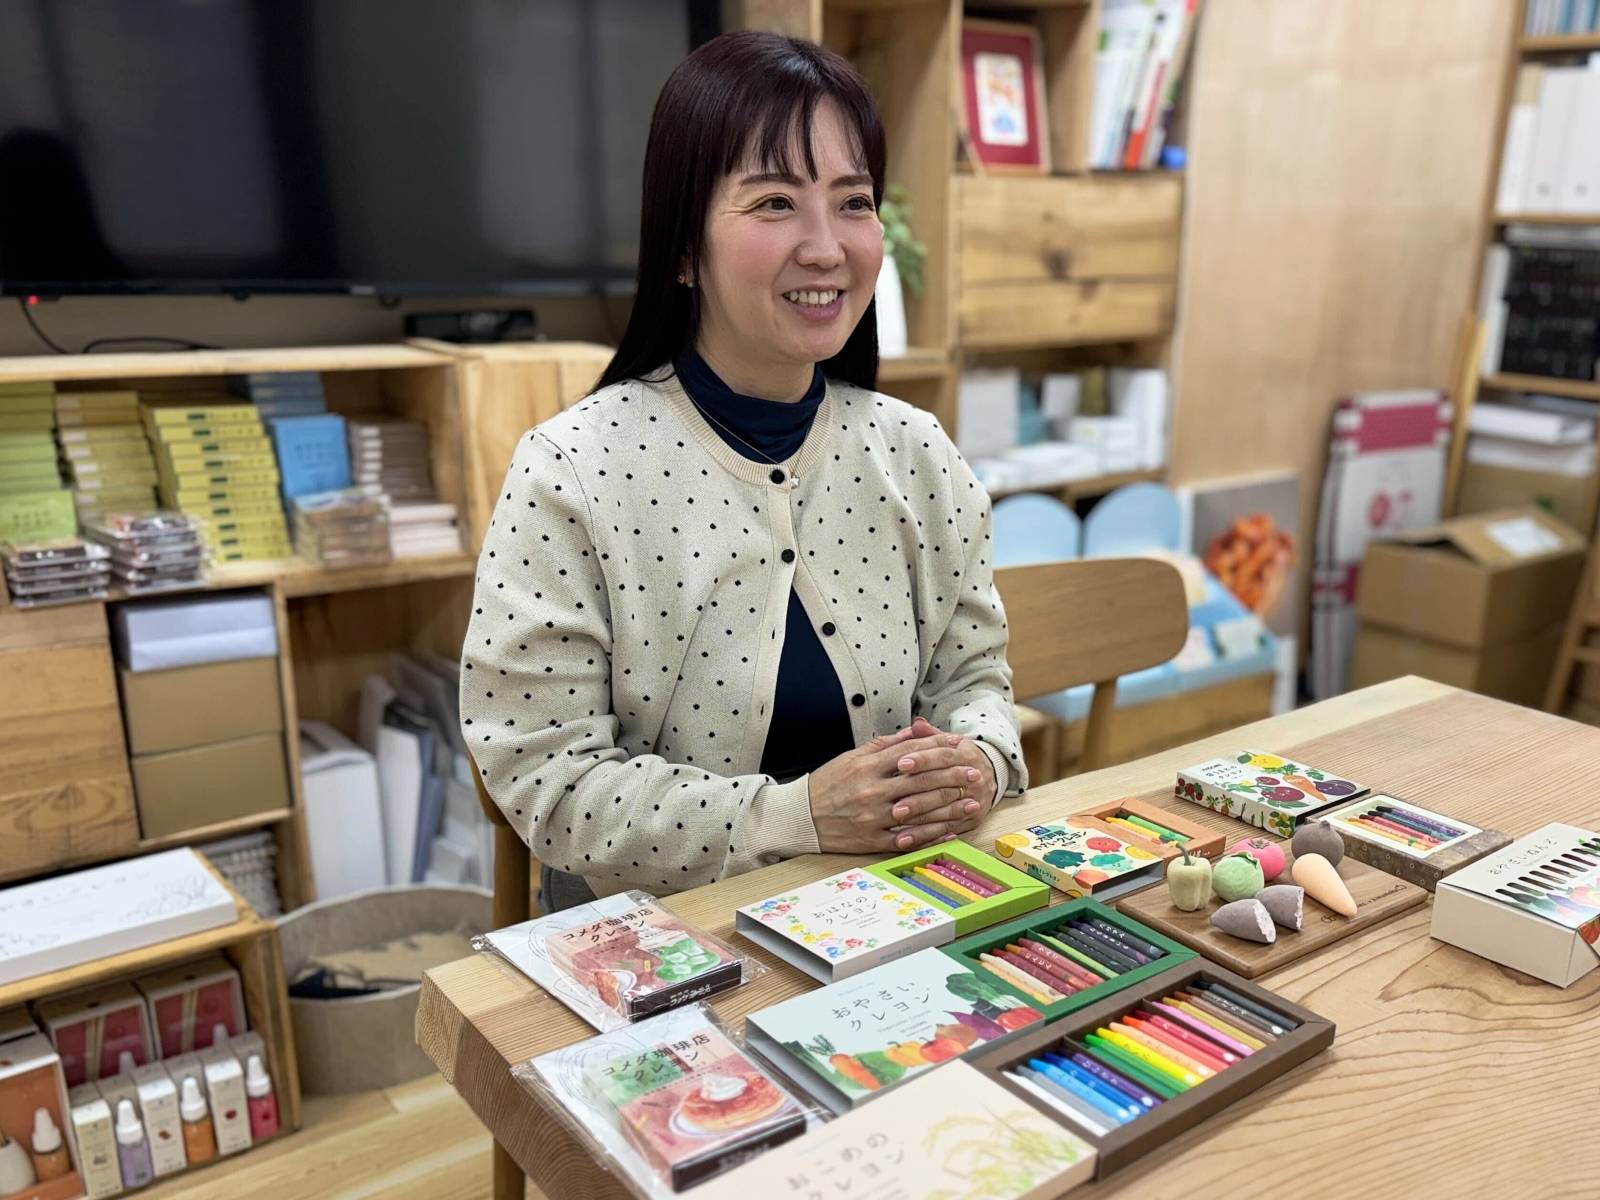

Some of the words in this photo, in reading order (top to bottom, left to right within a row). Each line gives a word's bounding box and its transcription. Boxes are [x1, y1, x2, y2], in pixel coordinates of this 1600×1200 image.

[1488, 836, 1558, 875] おやさいねんど
[562, 908, 654, 941] コメダ珈琲店
[811, 896, 868, 919] おはなの
[825, 903, 878, 925] クレヨン
[590, 920, 645, 944] クレヨン
[831, 982, 916, 1019] おやさい
[851, 988, 930, 1032] クレヨン
[601, 1033, 711, 1077] コメダ珈琲店
[633, 1050, 700, 1082] クレヨン
[786, 1133, 889, 1190] おこめの
